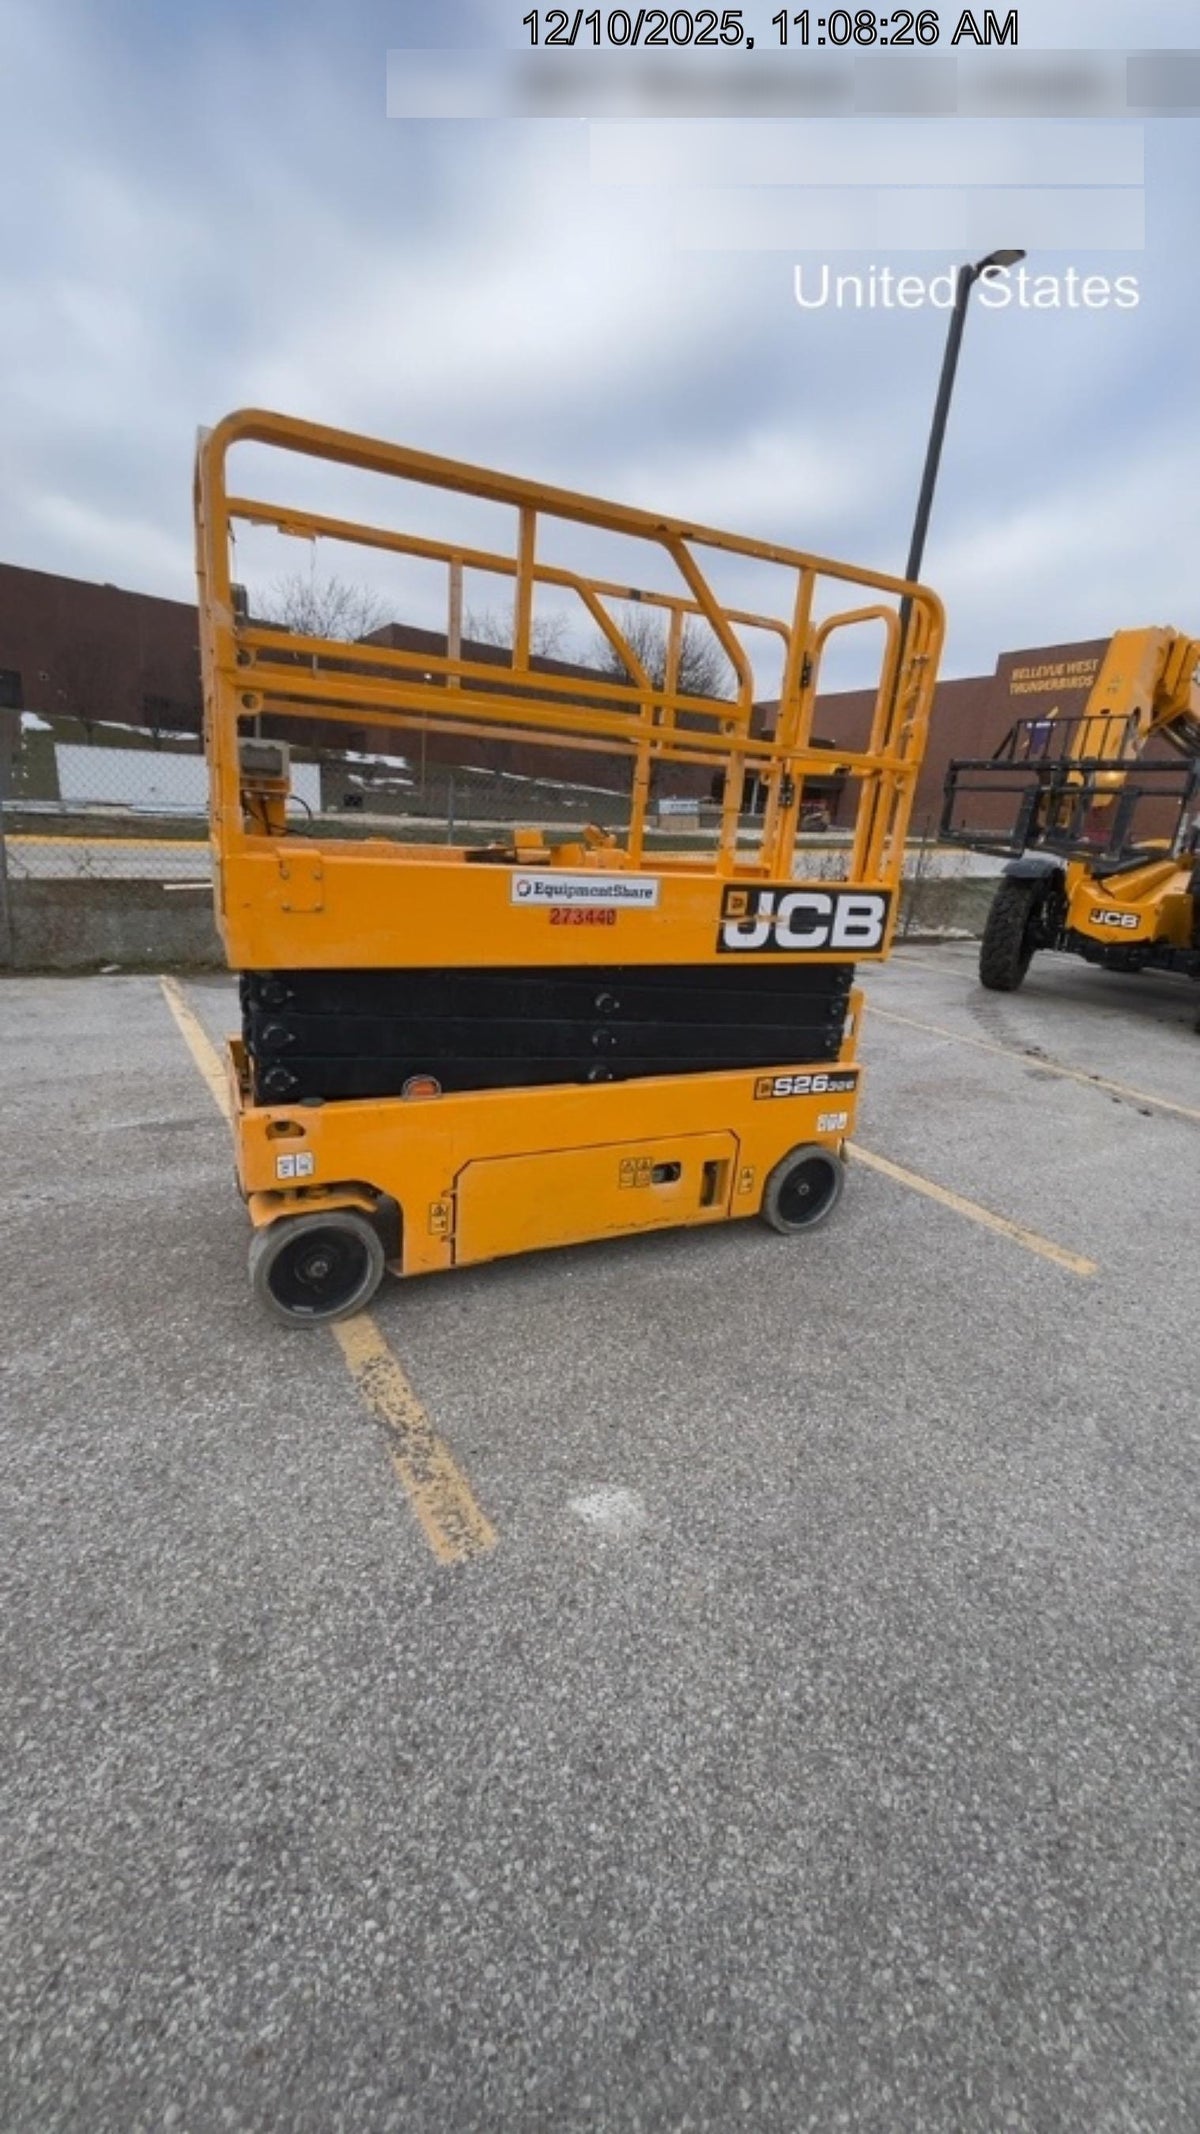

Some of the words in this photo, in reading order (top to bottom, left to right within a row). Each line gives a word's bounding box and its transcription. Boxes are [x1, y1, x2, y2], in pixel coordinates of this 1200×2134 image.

[1012, 664, 1065, 680] BELLEVUE
[1066, 659, 1099, 674] WEST
[533, 881, 653, 899] EquipmentShare
[549, 907, 616, 925] 273440
[722, 891, 886, 949] JCB
[1090, 909, 1138, 928] JCB
